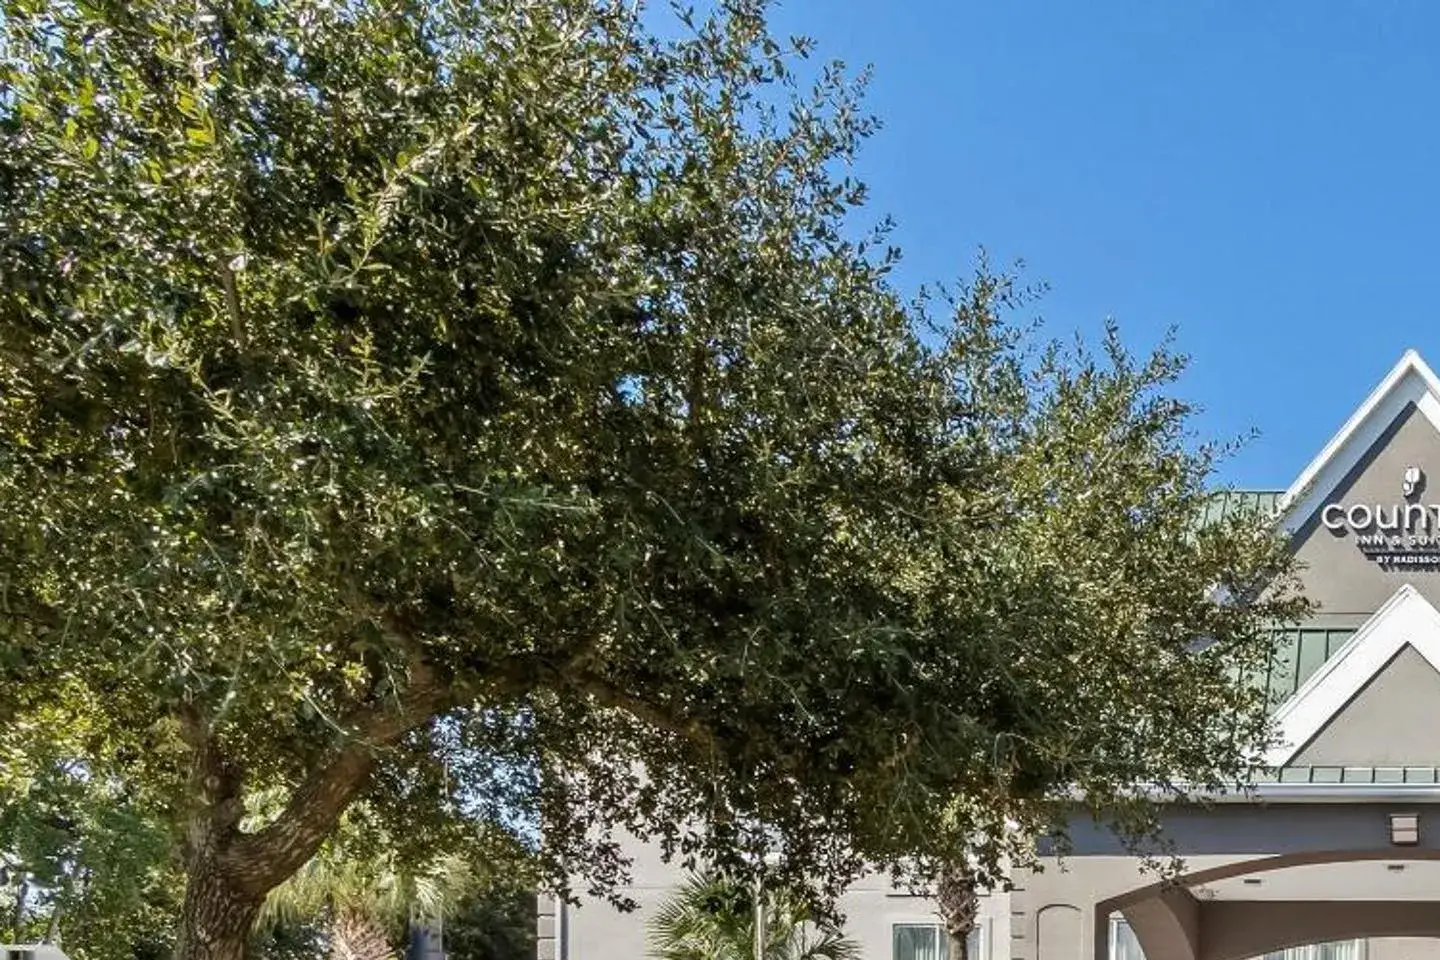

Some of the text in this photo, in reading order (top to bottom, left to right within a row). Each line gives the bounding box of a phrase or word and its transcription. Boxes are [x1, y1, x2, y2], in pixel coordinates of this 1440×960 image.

[1354, 535, 1384, 545] INN
[1391, 535, 1401, 546] &
[1376, 556, 1391, 564] BY
